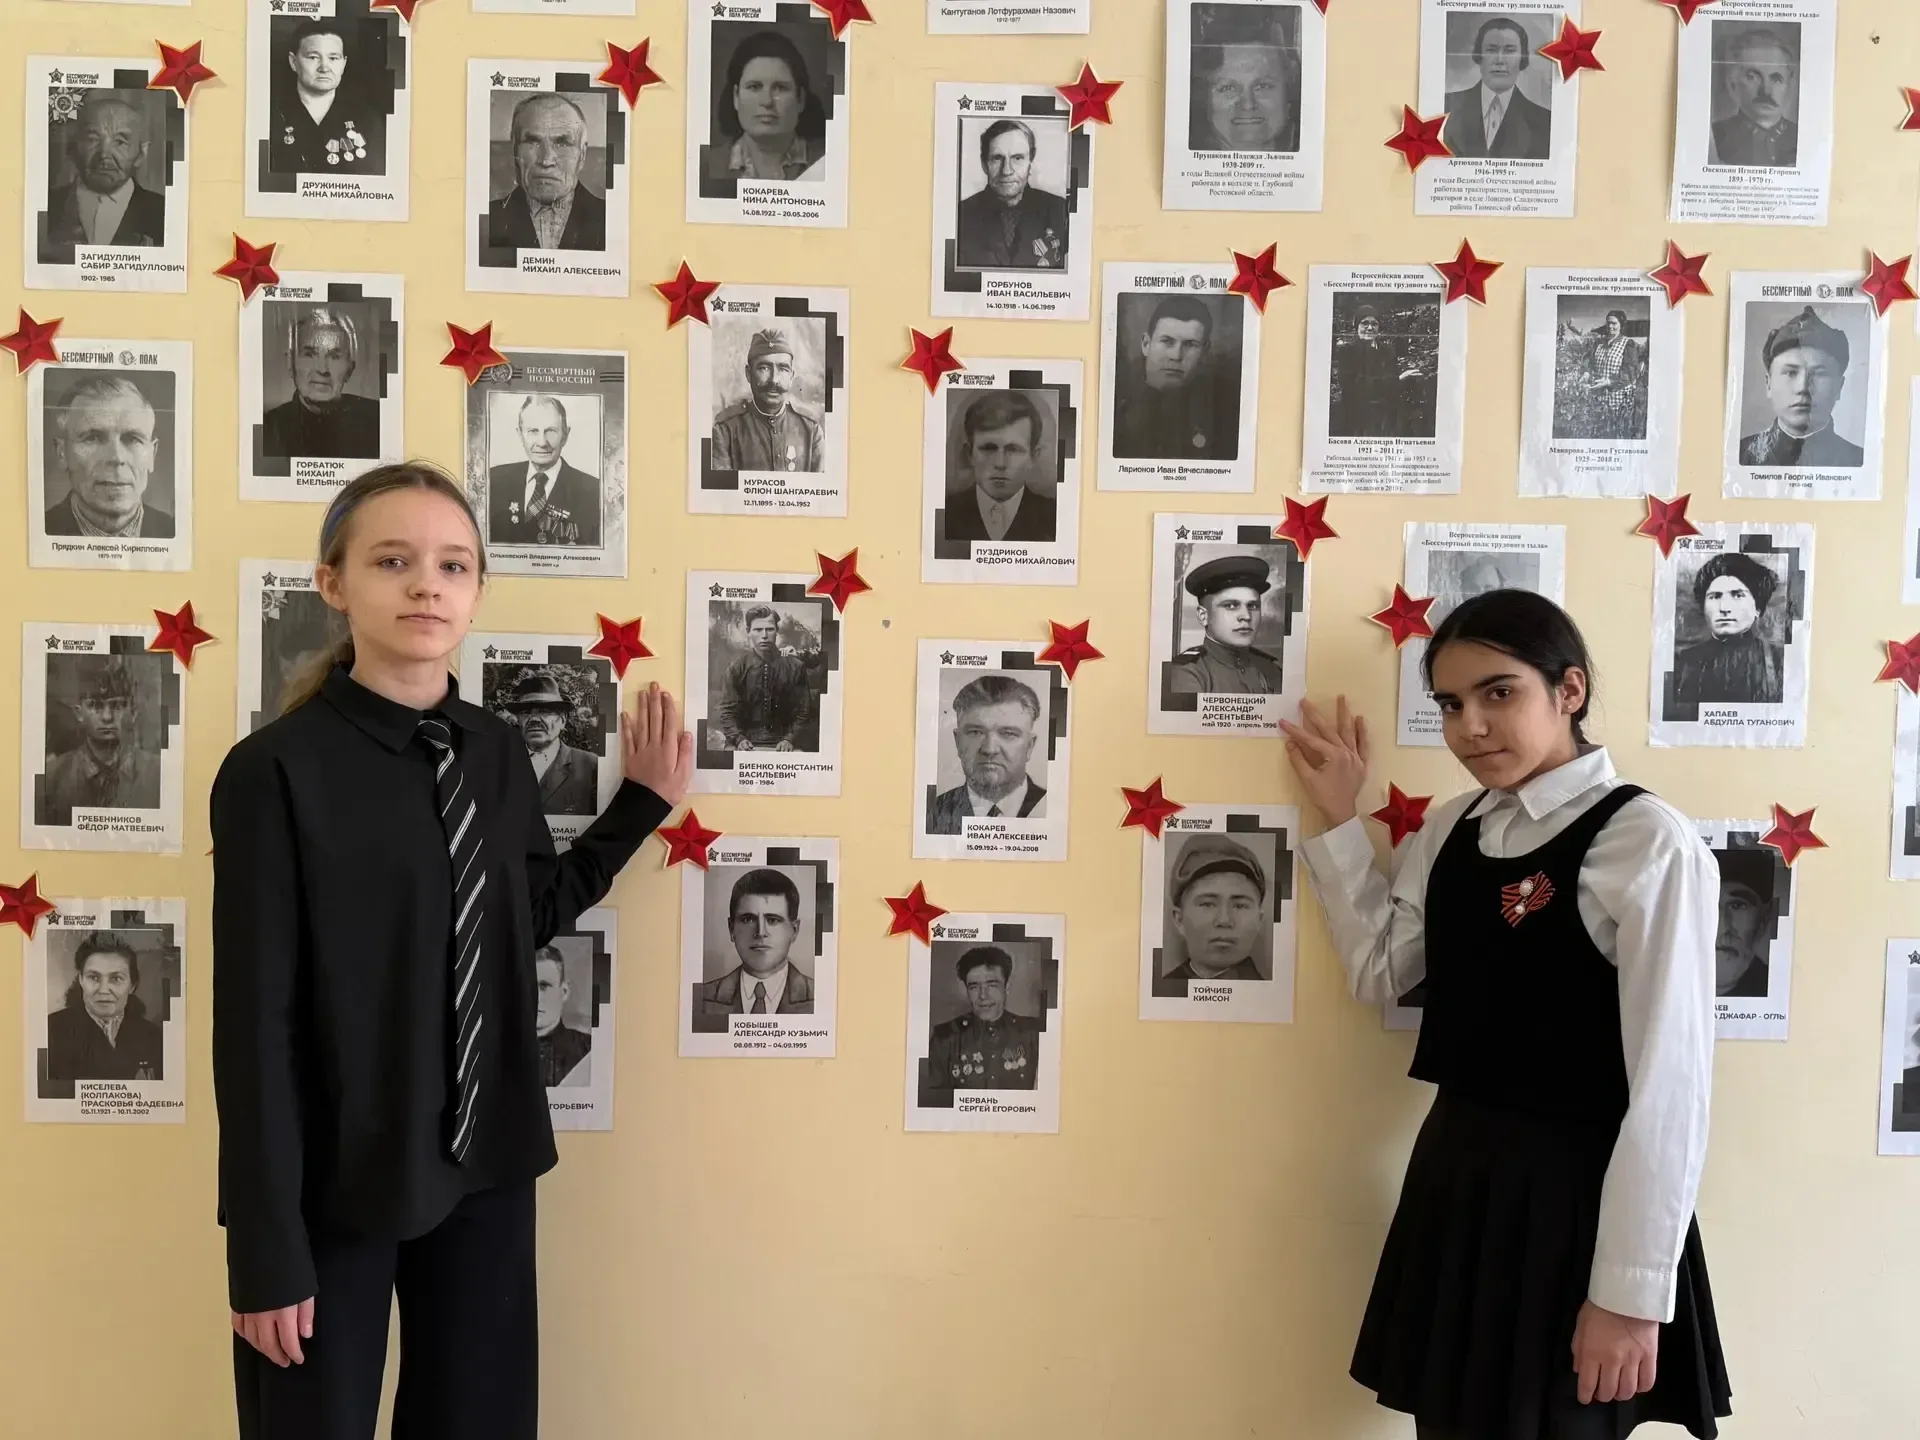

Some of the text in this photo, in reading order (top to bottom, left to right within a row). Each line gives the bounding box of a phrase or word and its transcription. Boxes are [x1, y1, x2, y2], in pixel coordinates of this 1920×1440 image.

[941, 8, 985, 17] Кантуганов
[987, 7, 1040, 16] Лотфурахман
[302, 181, 360, 190] ДРУЖИНИНА
[330, 191, 393, 199] МИХАЙЛОВНА
[743, 187, 789, 195] КОКАРЕВА
[770, 197, 825, 206] АНТОНОВНА
[782, 210, 819, 218] 20.05.2006
[81, 253, 140, 261] ЗАГИДУЛЛИН
[112, 262, 184, 271] ЗАГИДУЛЛОВИЧ
[523, 265, 620, 275] МИХАИЛ АЛЕКСЕЕВИЧ
[1134, 276, 1227, 288] БЕССМЕРТНЫЙ ПОЛК
[1013, 290, 1070, 298] ВАСИЛЬЕВИЧ
[1762, 285, 1854, 297] БЕССМЕРТНЫЙ ПОЛК
[62, 351, 158, 365] БЕССМЕРТНЫЙ ПОЛК
[527, 367, 595, 375] БЕССМЕРТНЫЙ
[1118, 465, 1230, 474] Ларионов Иван Вячеславович
[1749, 472, 1782, 480] Томилов
[1783, 473, 1813, 481] Георгий
[51, 542, 168, 553] Прядкин Алексей Кириллович
[976, 548, 1027, 556] ПУЗДРИКОВ
[1202, 696, 1265, 704] ЧЕРВОНЕЦКИЙ
[1202, 705, 1254, 713] АЛЕКСАНДР
[1703, 718, 1744, 726] АБДУЛЛА
[77, 823, 163, 832] ФЁДОР МАТВЕЕВИЧ
[550, 827, 576, 835] ХМАН
[1719, 1013, 1757, 1021] ДЖАФАР
[548, 1103, 593, 1111] ГОРЬЕВИЧ
